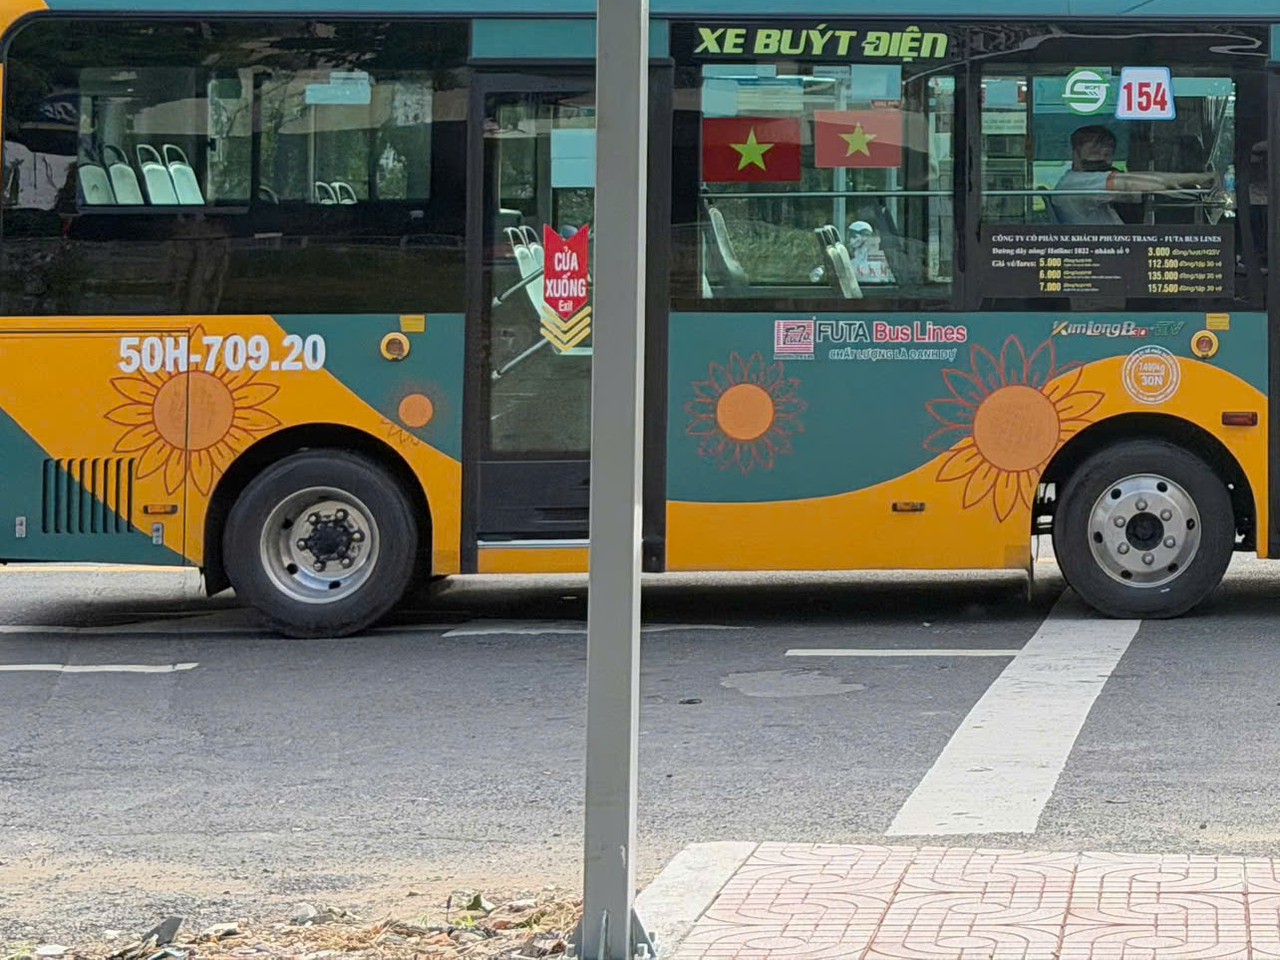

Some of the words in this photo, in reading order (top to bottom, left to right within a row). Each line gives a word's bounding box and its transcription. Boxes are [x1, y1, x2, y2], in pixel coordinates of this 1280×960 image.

[694, 27, 747, 54] XE
[753, 23, 857, 56] BUÝT
[861, 25, 948, 62] ĐIỆN
[1122, 82, 1168, 112] 154
[1071, 233, 1098, 242] KHÁCH
[1147, 247, 1170, 256] 3.000
[554, 245, 579, 272] CỬA
[1040, 257, 1062, 267] 5.000
[1148, 259, 1179, 268] 112.500
[1039, 269, 1062, 279] 6.000
[1148, 271, 1179, 280] 135.000
[545, 271, 587, 298] XUỐNG
[1039, 282, 1062, 292] 7.000
[1148, 284, 1179, 293] 157.500
[558, 299, 573, 312] Exit
[816, 321, 870, 343] FUTA
[873, 321, 912, 343] Bus
[913, 321, 966, 343] Lines
[119, 332, 326, 374] 50H-709.20
